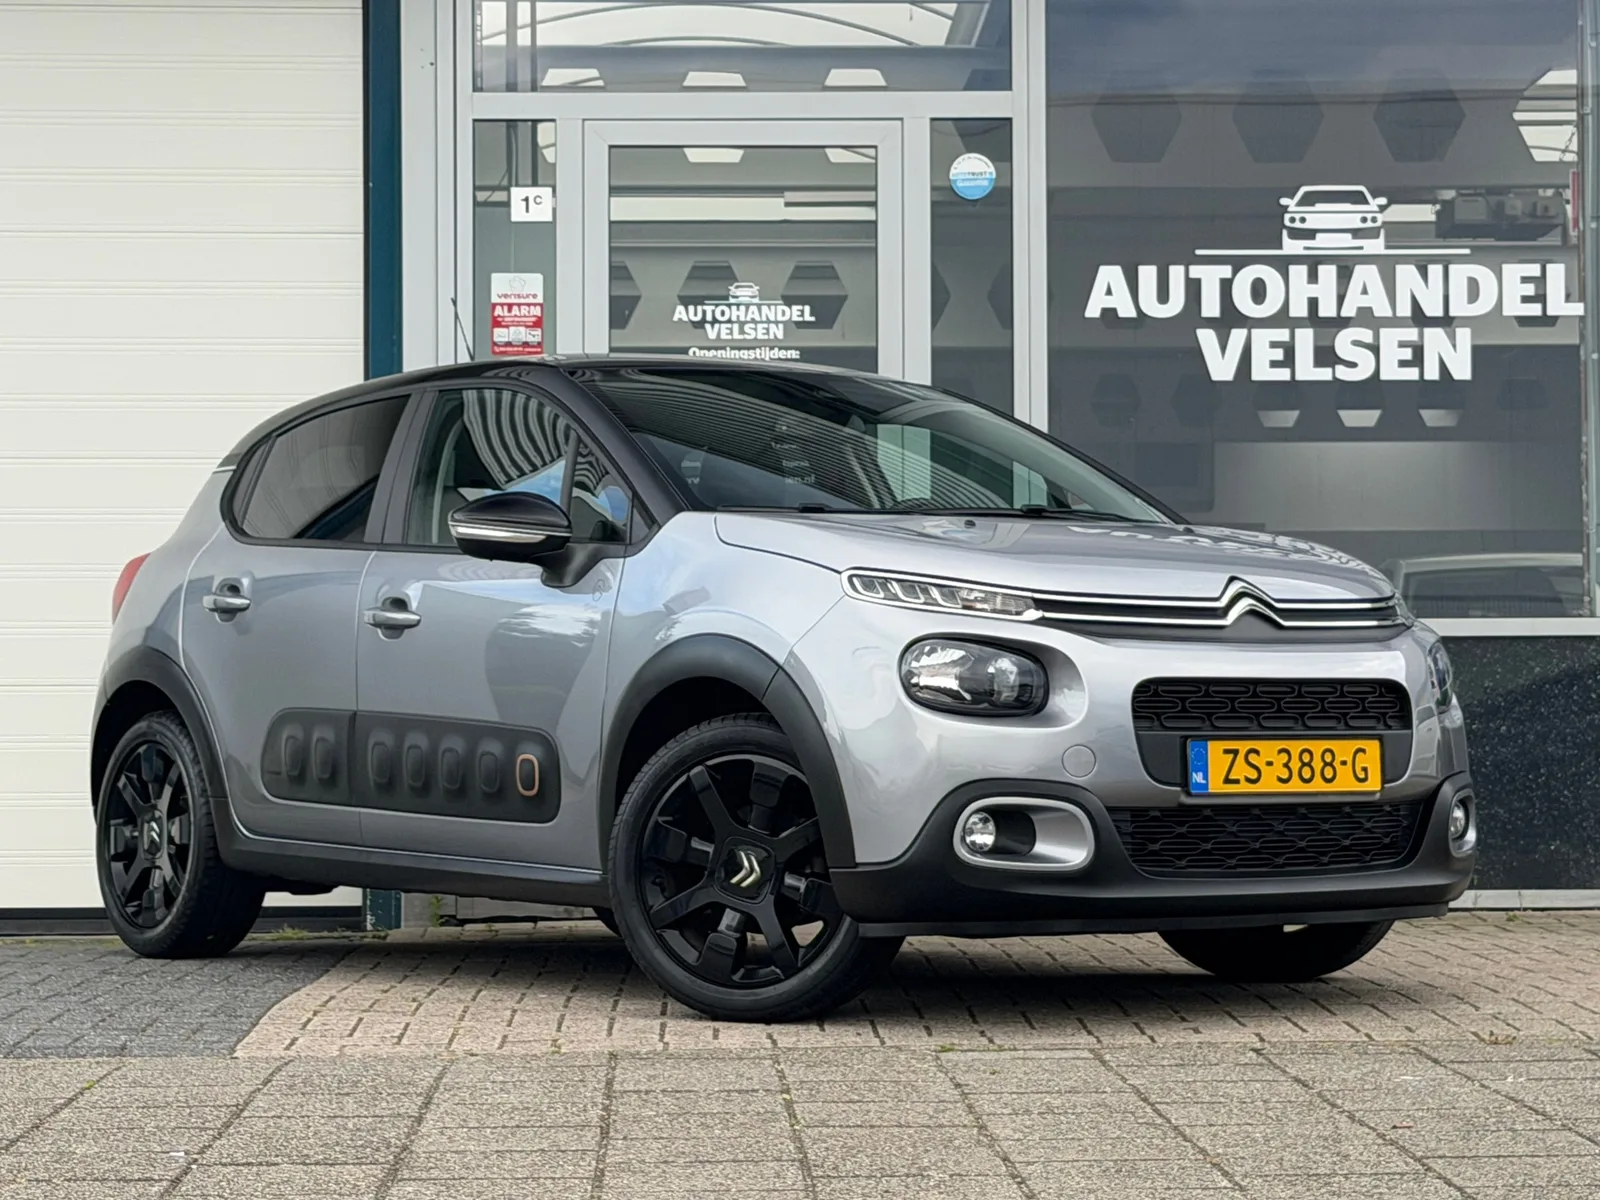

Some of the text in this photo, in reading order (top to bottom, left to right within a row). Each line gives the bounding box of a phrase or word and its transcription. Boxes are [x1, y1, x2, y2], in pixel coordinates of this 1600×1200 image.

[496, 292, 538, 300] verisure
[1084, 263, 1585, 318] AUTOHANDEL
[493, 305, 542, 317] ALARM
[672, 304, 816, 322] AUTOHANDEL
[704, 323, 785, 340] VELSEN
[1195, 327, 1472, 381] VELSEN
[1222, 747, 1370, 785] ZS-388-G
[1192, 771, 1207, 784] NL
